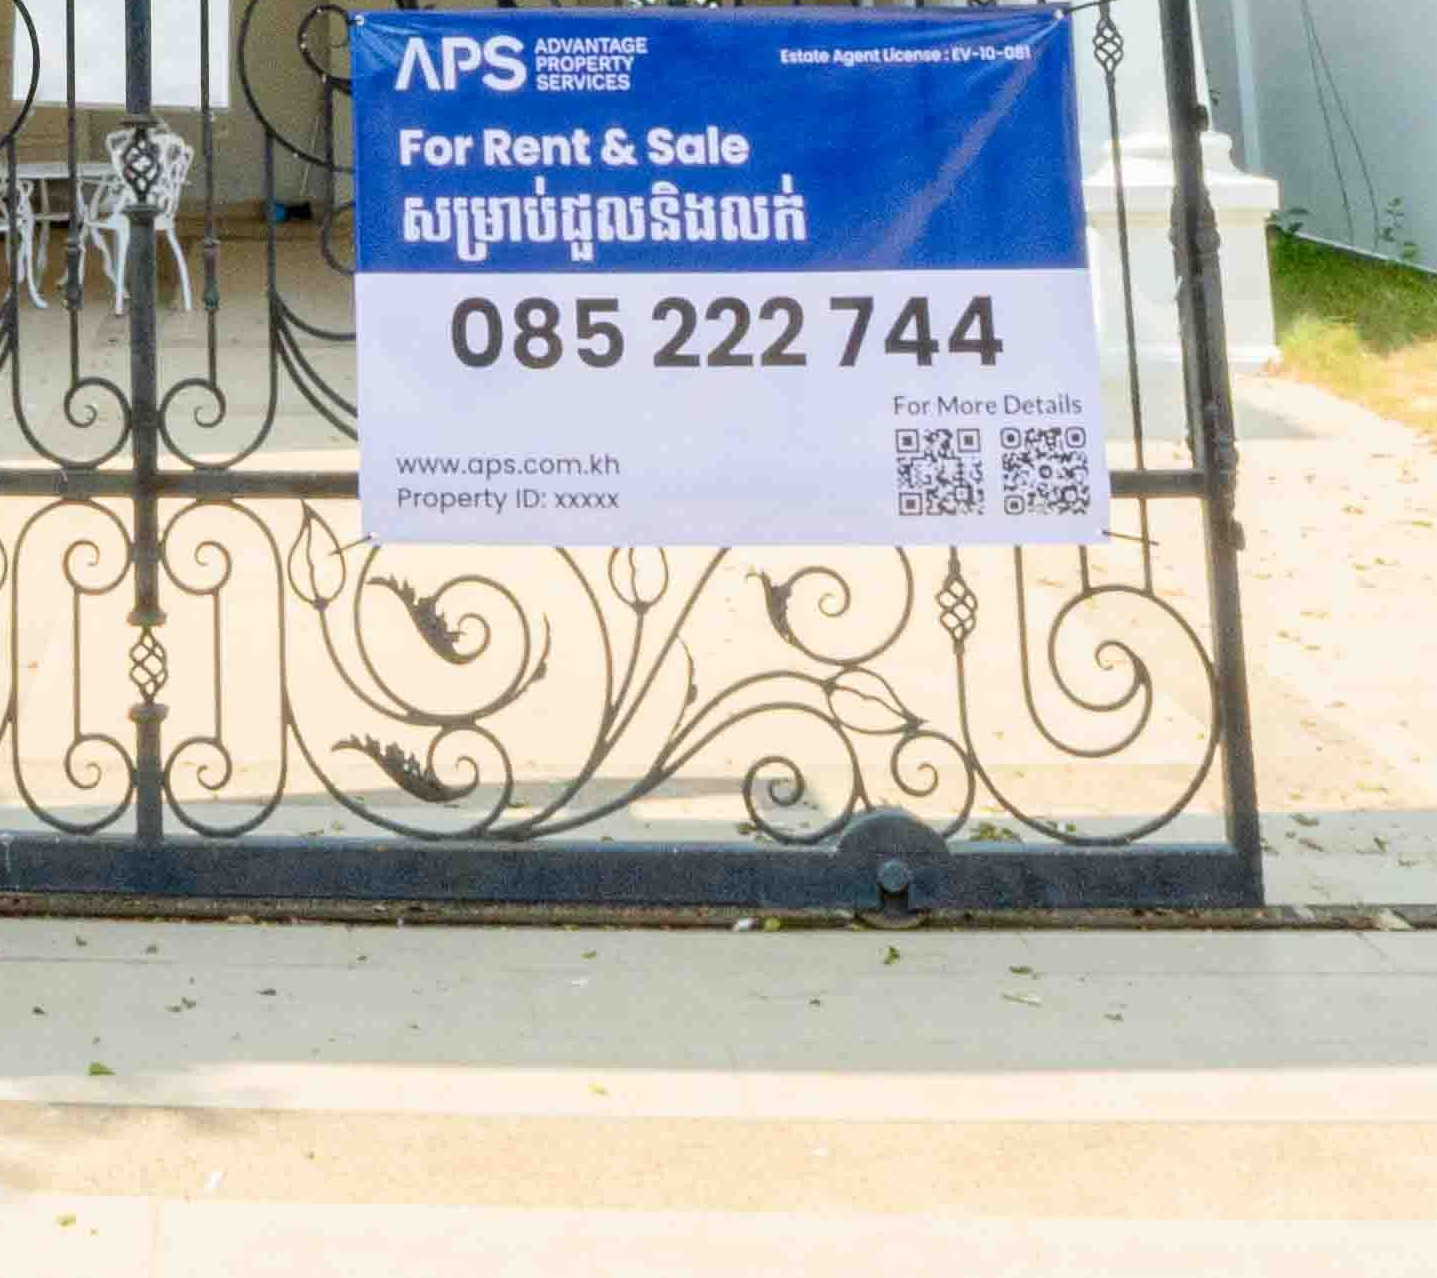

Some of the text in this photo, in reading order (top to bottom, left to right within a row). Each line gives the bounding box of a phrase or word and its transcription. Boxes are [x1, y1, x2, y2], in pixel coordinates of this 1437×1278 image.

[534, 37, 648, 54] ADVANTAGE
[780, 48, 831, 64] Estate
[833, 48, 881, 67] Agent
[883, 46, 941, 63] License
[394, 35, 528, 92] APS
[535, 55, 635, 73] PROPERTY
[536, 73, 631, 91] SERVICES
[399, 125, 750, 166] For Rent & Sale
[452, 295, 1004, 369] 085 222 744
[893, 393, 1083, 415] For More Details
[396, 453, 621, 480] www.aps.com.kh
[397, 487, 620, 514] Property ID: xxxxx
